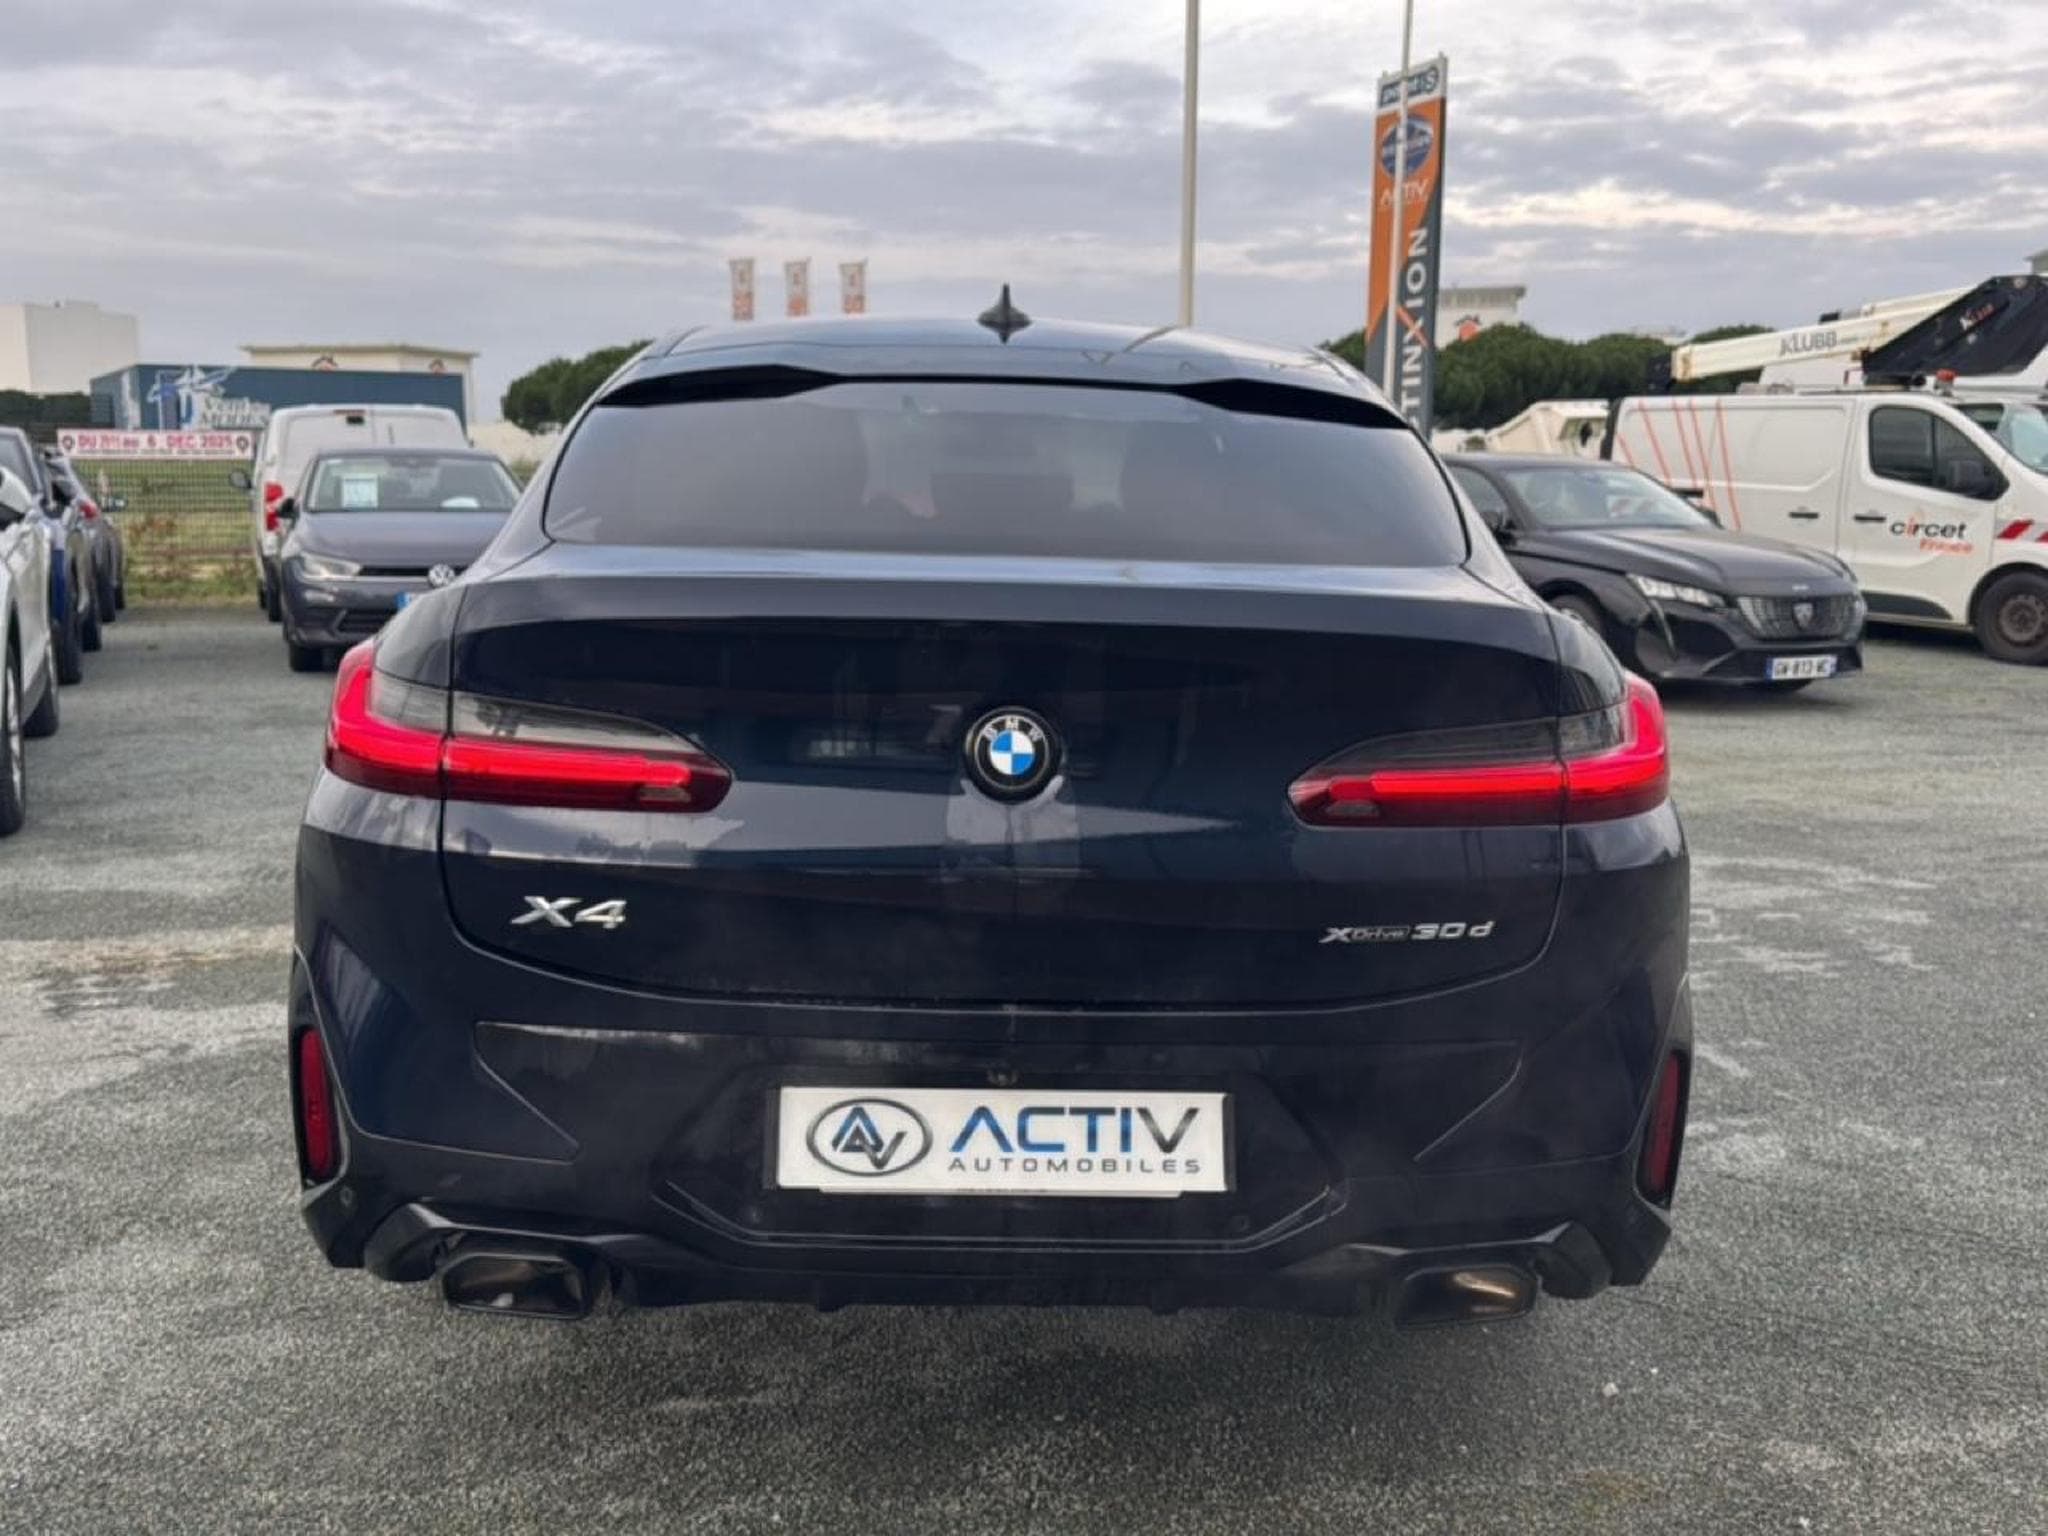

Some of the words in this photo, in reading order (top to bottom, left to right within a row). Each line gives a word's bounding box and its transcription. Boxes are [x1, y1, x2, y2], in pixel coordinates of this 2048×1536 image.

[1890, 516, 1967, 538] circet
[511, 895, 627, 929] X4
[950, 1106, 1200, 1154] ACTIV
[948, 1157, 1201, 1174] AUTOMOBILES
